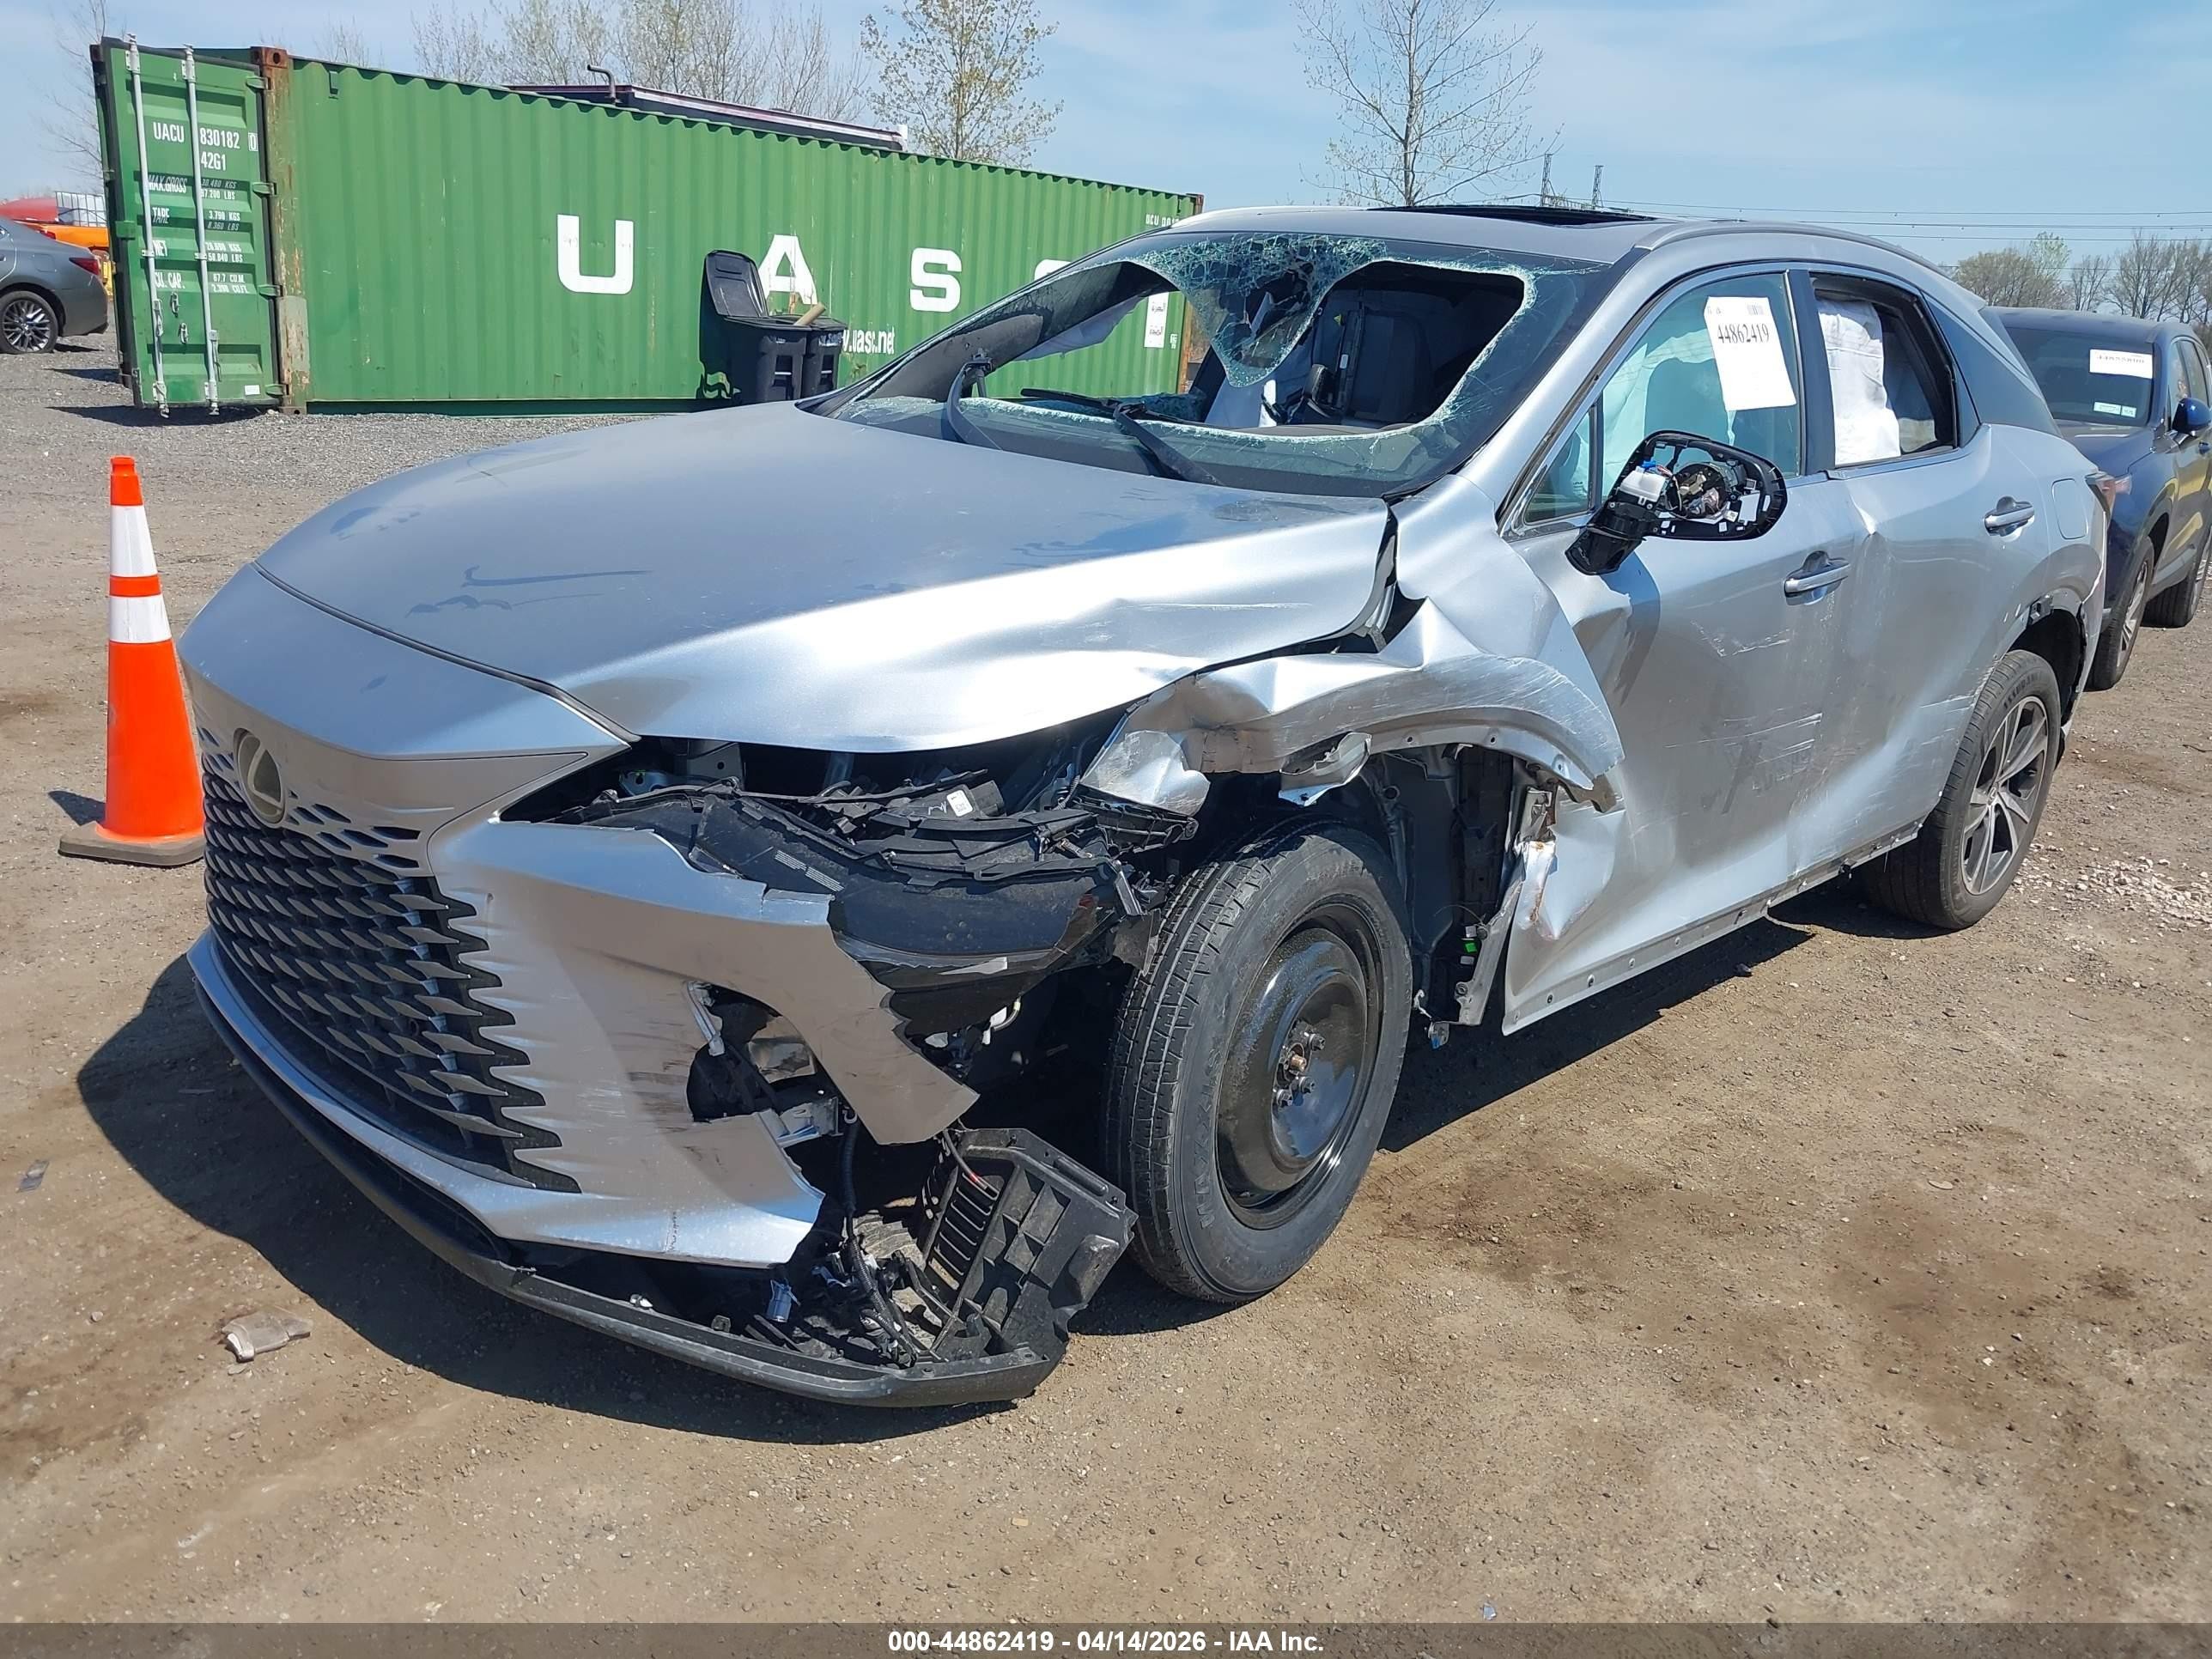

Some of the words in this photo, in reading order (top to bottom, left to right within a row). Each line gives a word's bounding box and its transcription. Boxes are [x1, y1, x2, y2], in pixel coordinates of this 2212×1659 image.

[153, 122, 185, 143] UACU
[199, 127, 240, 149] 830182
[248, 133, 258, 151] 0
[200, 151, 226, 171] 42G1
[149, 174, 187, 193] MAX.GROSS
[225, 180, 237, 189] KGS
[224, 191, 235, 200] LBS
[152, 207, 170, 224] TARE
[228, 212, 240, 222] KGS
[228, 222, 239, 231] LBS
[152, 240, 167, 257] NET
[231, 254, 243, 263] LBS
[1717, 323, 1770, 344] 44862419
